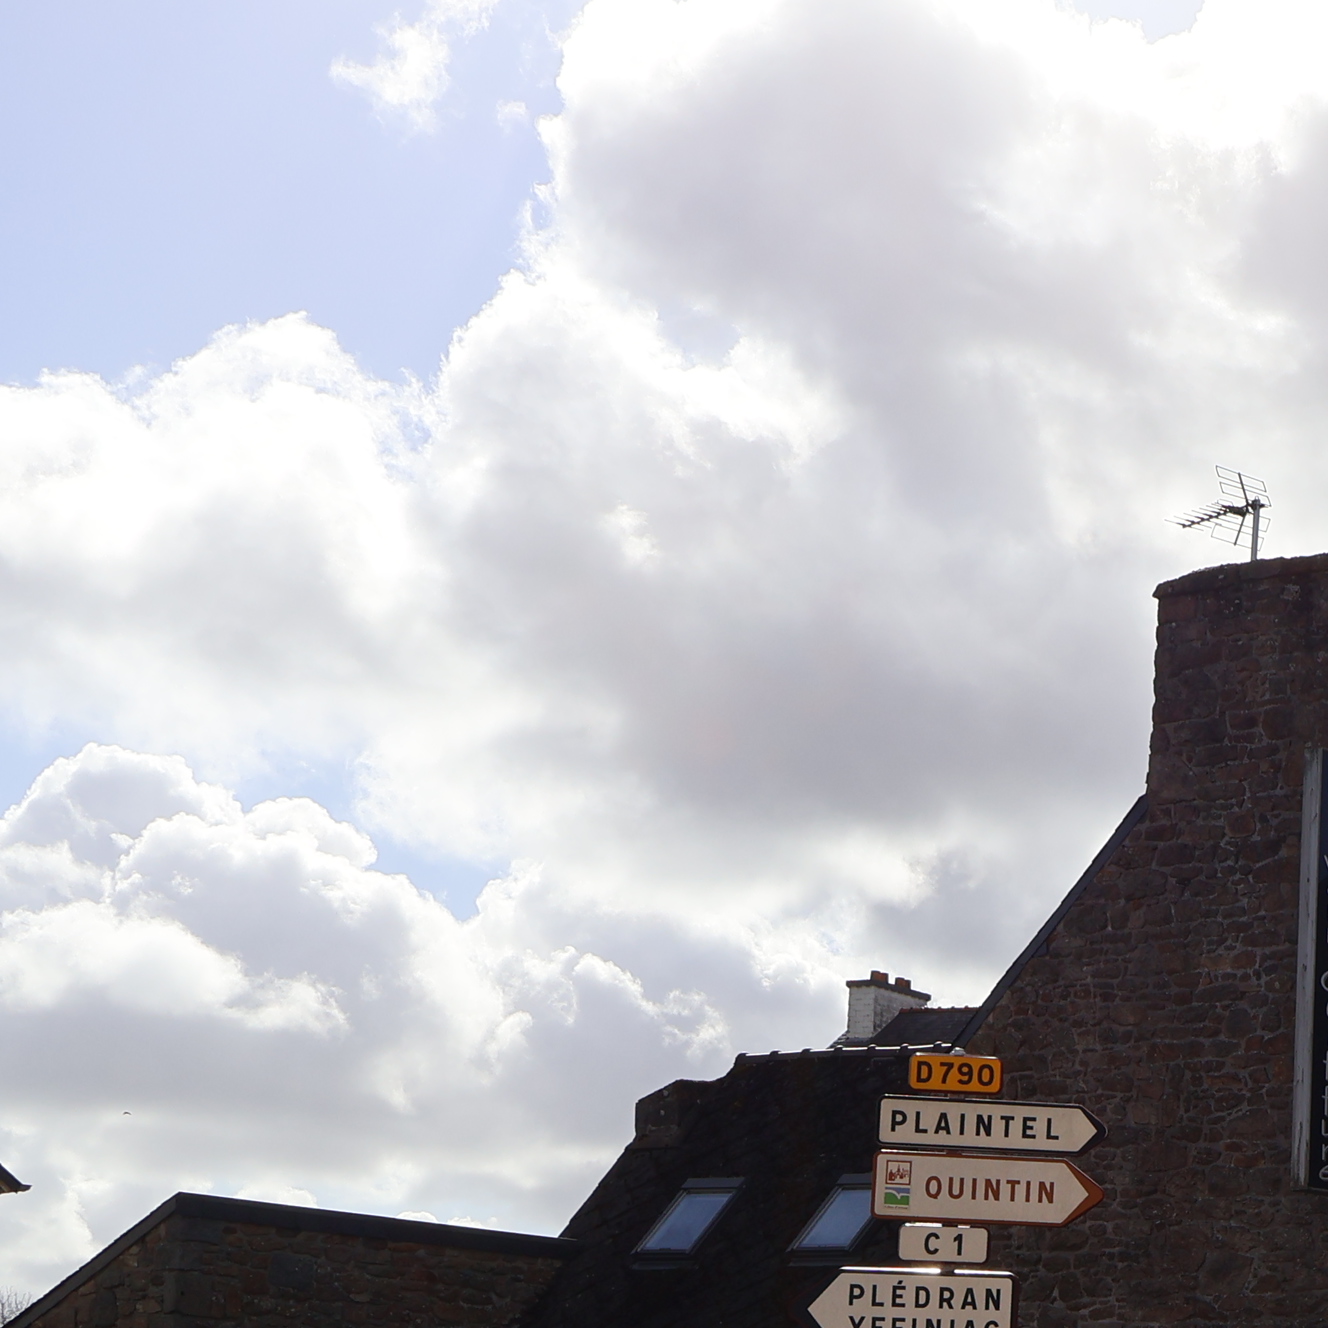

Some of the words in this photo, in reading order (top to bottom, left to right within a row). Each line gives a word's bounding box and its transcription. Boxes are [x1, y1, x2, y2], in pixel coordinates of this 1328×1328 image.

[891, 1109, 1060, 1141] PLAINTEL
[925, 1175, 1055, 1204] QUINTIN
[848, 1280, 1001, 1311] PLÉDRAN
